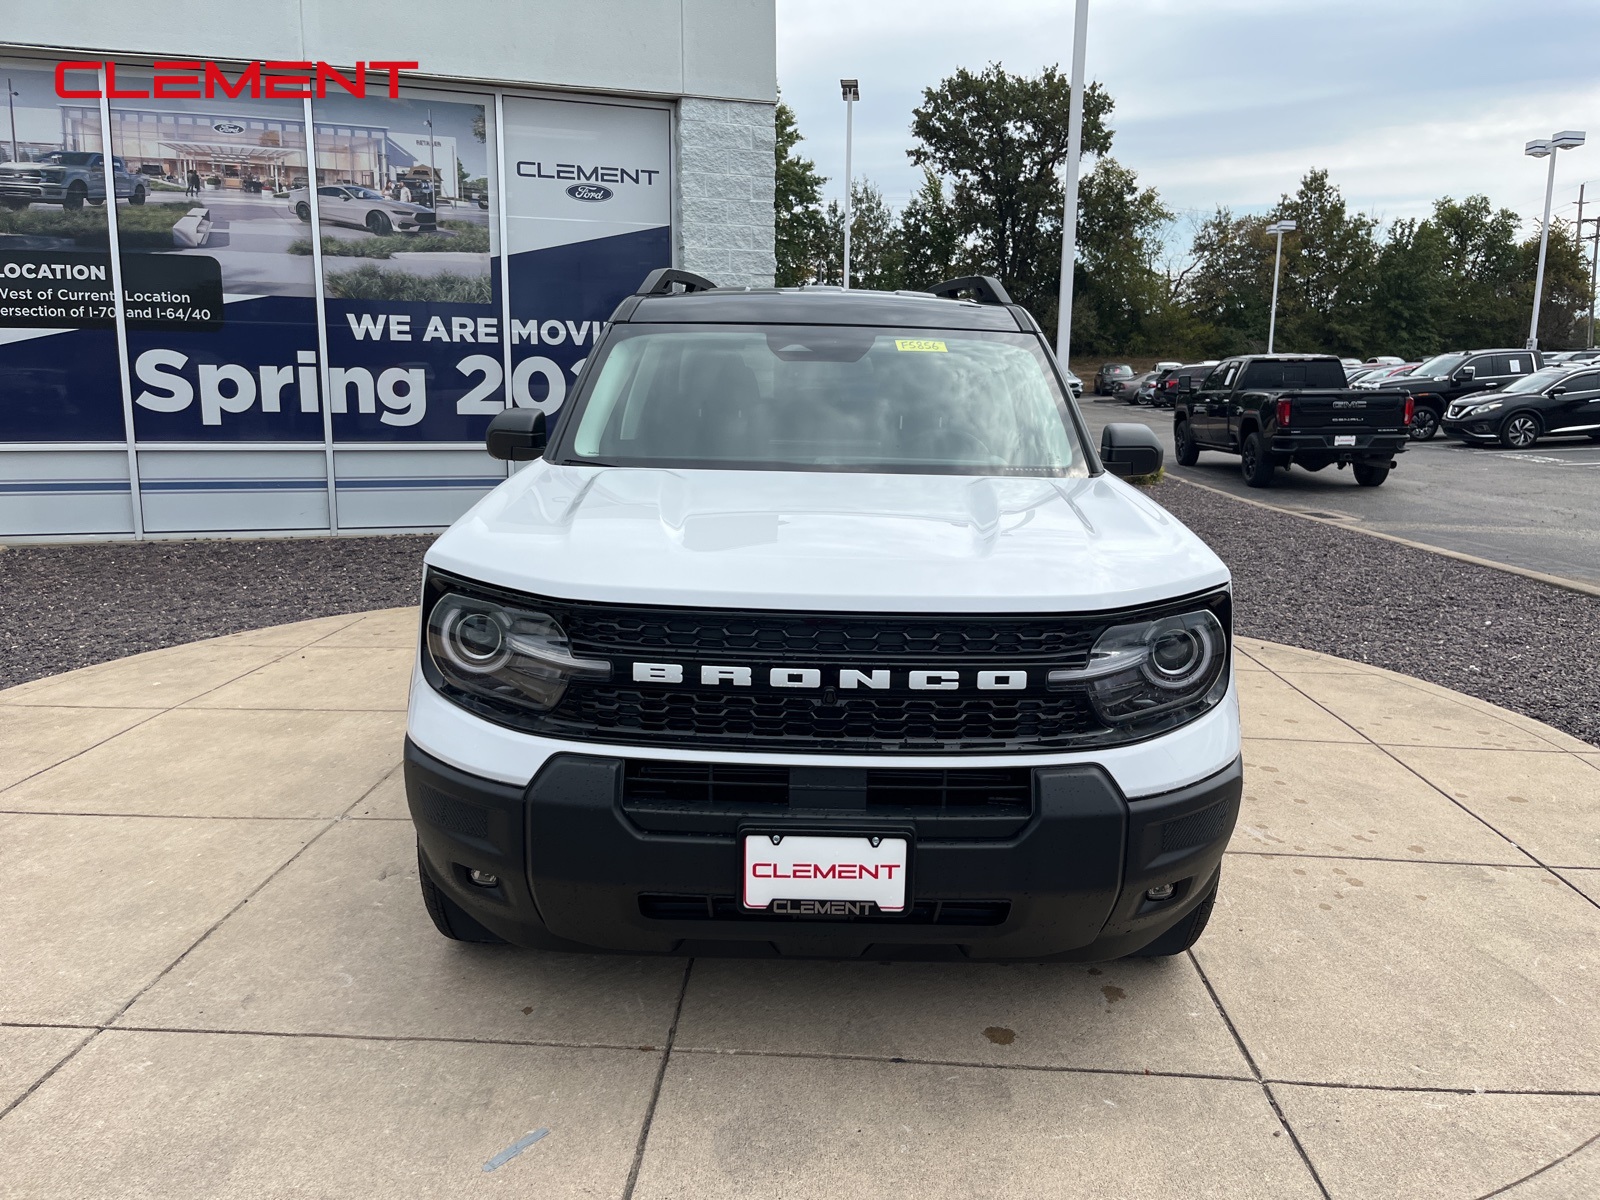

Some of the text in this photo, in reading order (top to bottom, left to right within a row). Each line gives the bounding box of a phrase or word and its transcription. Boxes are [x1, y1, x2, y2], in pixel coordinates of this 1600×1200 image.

[516, 161, 660, 186] CLEMENT
[575, 185, 604, 200] Ford
[37, 288, 53, 300] of
[57, 289, 115, 301] Current
[125, 290, 191, 303] Location
[70, 306, 85, 318] of
[89, 306, 116, 318] I-70
[126, 307, 152, 318] and
[157, 307, 211, 321] I-64/40
[346, 313, 608, 346] WE ARE MOVI
[135, 348, 588, 426] Spring 20
[633, 662, 1027, 690] BRONCO
[752, 863, 901, 880] CLEMENT
[773, 900, 875, 915] CLEMENT
